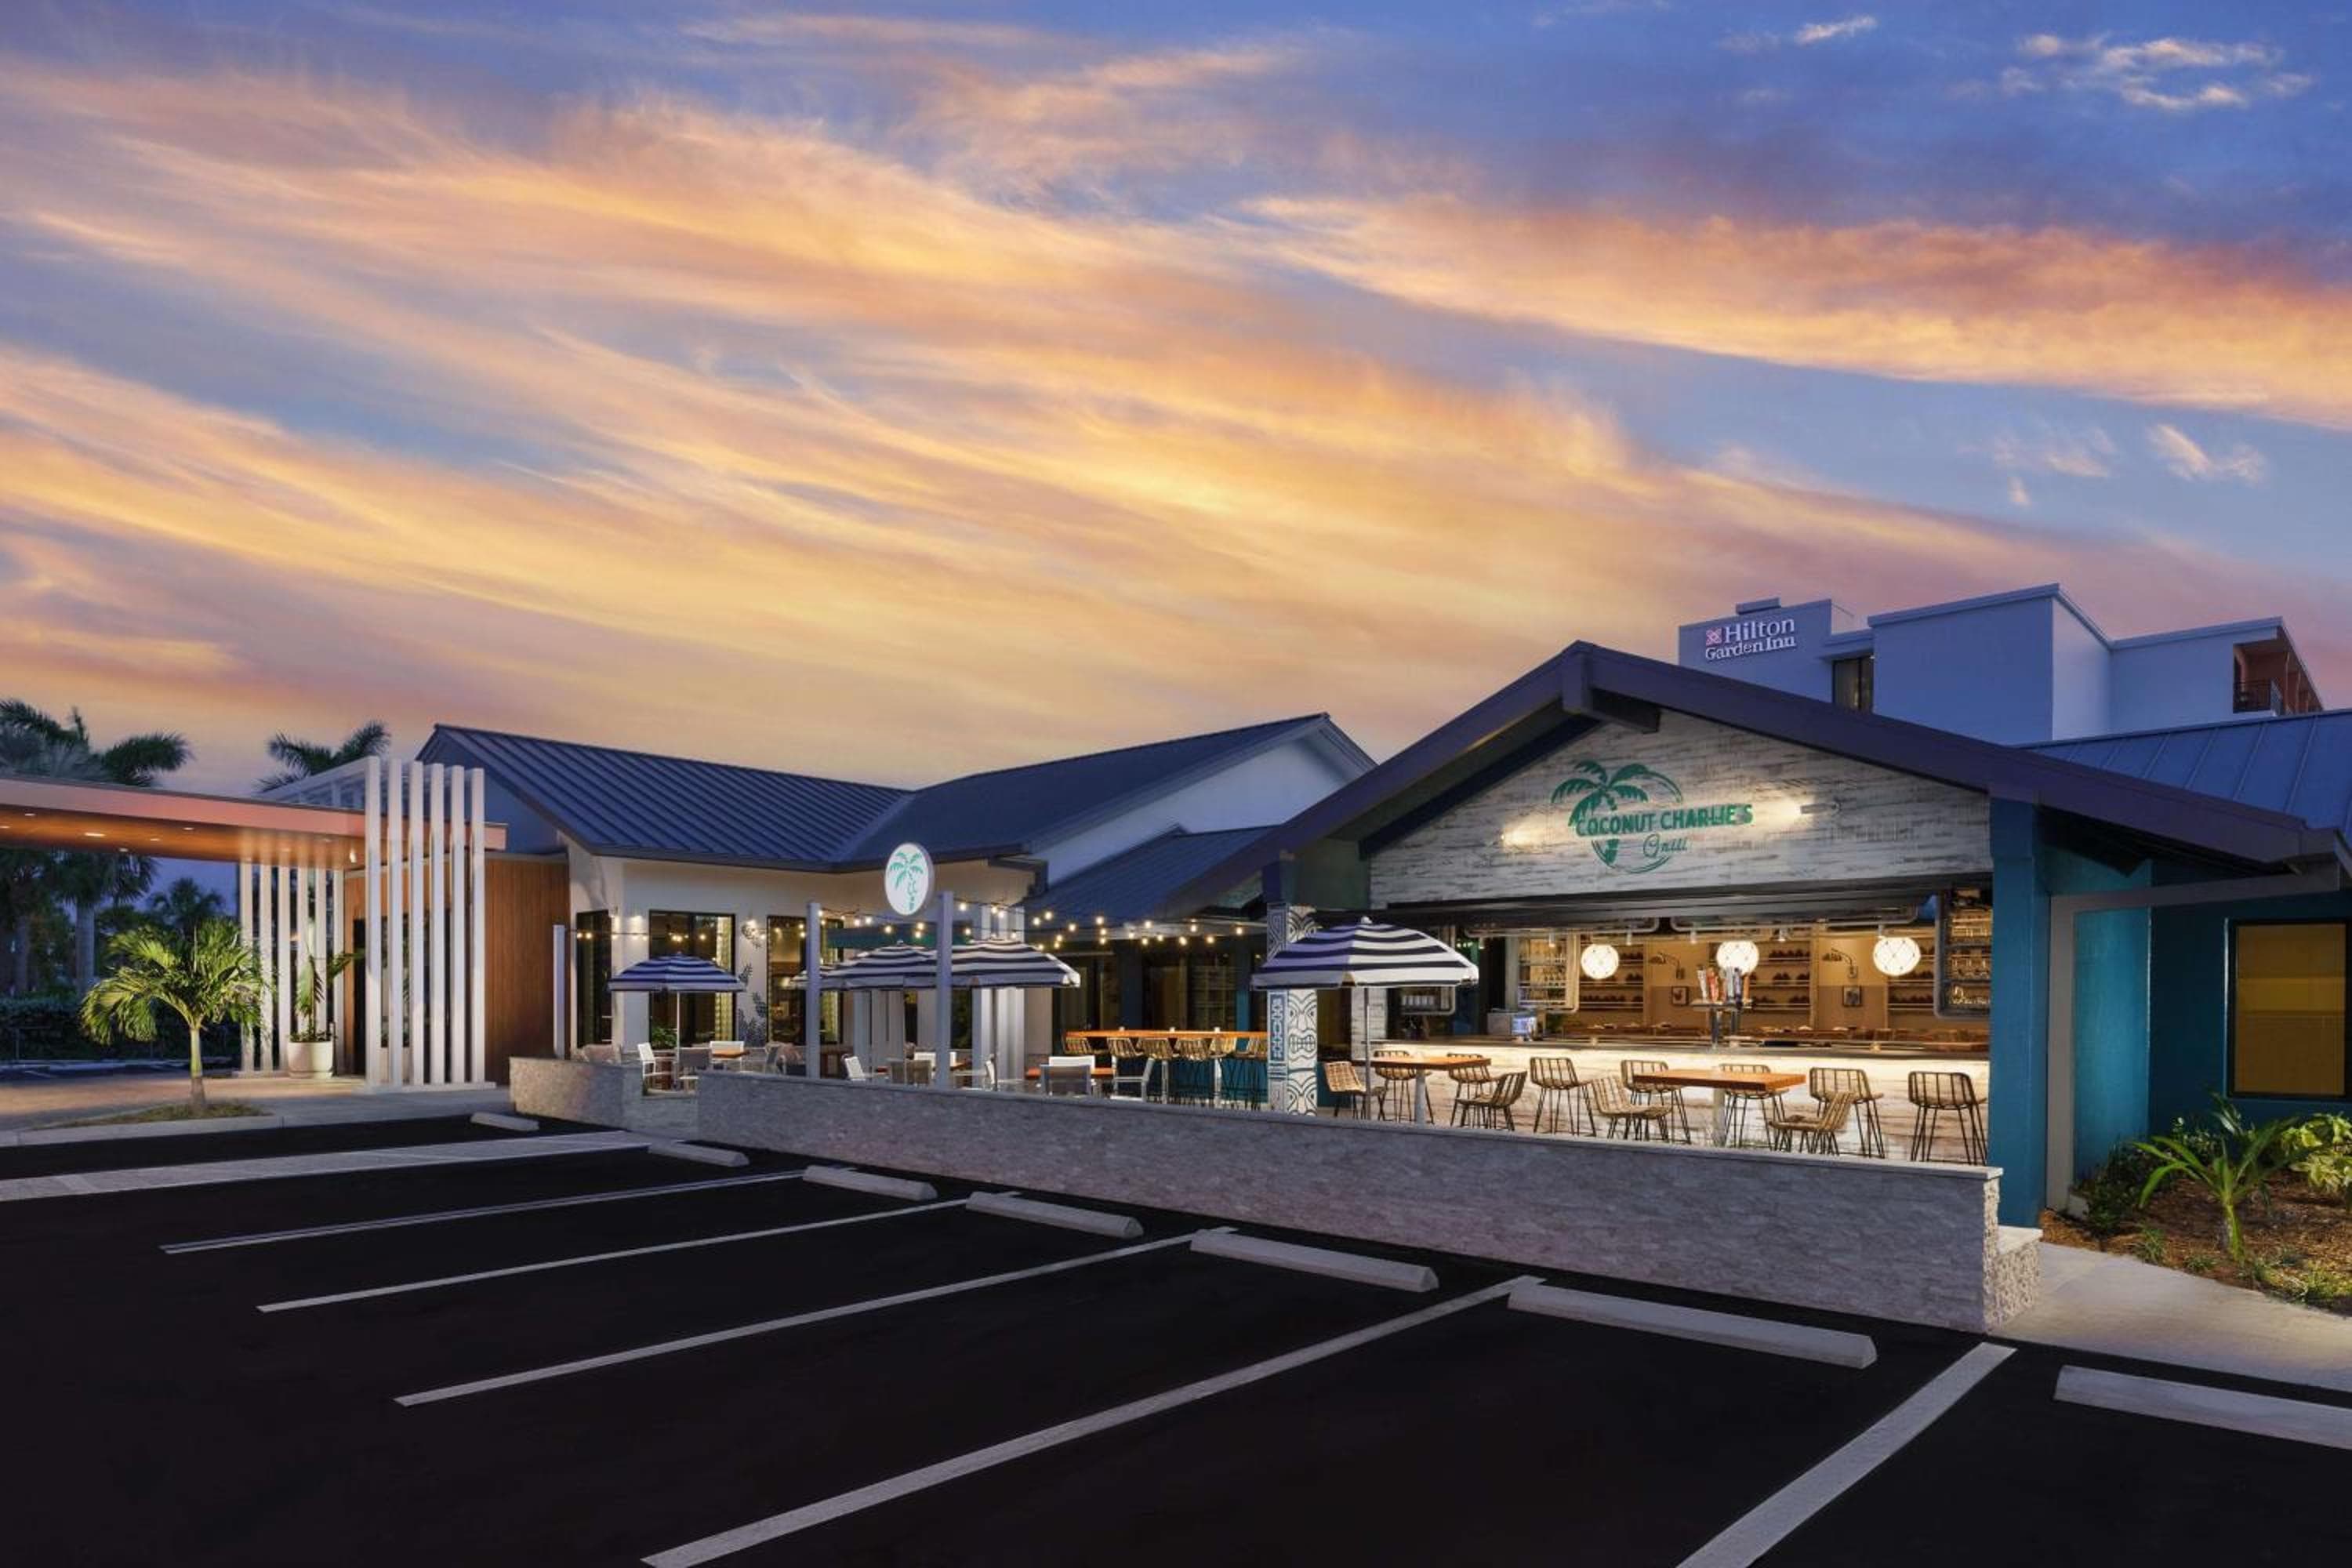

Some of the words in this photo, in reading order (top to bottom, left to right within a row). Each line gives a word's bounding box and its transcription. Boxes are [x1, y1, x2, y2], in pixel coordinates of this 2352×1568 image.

[1725, 619, 1795, 643] Hilton
[1705, 641, 1763, 659] Garden
[1766, 636, 1796, 652] Inn
[1576, 812, 1656, 837] COCONUT
